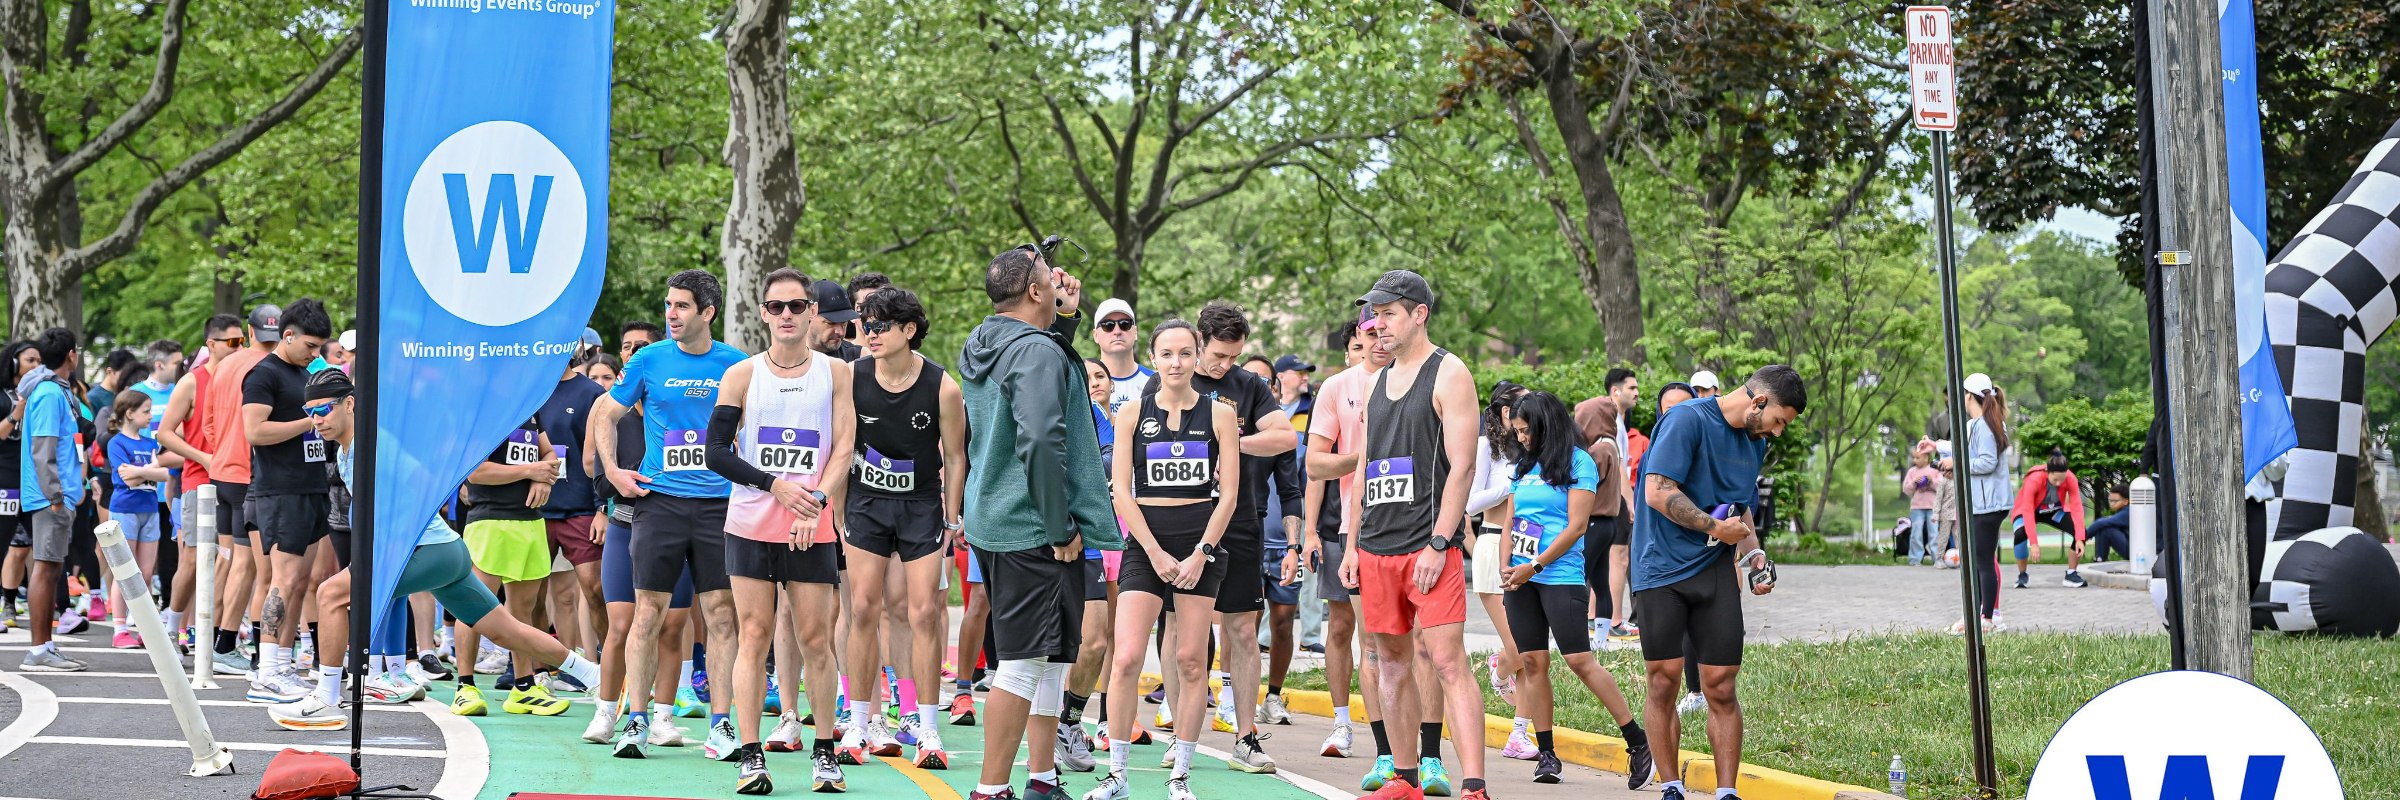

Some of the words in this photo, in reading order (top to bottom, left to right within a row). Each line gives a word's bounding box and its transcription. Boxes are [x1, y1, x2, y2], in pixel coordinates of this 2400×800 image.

[486, 0, 543, 12] Events
[1920, 15, 1937, 37] NO
[1910, 43, 1950, 65] PARKING
[1924, 71, 1938, 84] ANY
[1923, 90, 1942, 103] TIME
[442, 172, 555, 274] W
[402, 342, 475, 361] Winning
[479, 341, 529, 357] Events
[307, 443, 324, 459] 666
[667, 447, 704, 467] 606
[760, 446, 814, 470] 6074
[864, 465, 910, 489] 6200
[1151, 461, 1206, 482] 6684
[1368, 478, 1409, 502] 6137
[1511, 533, 1536, 556] 714
